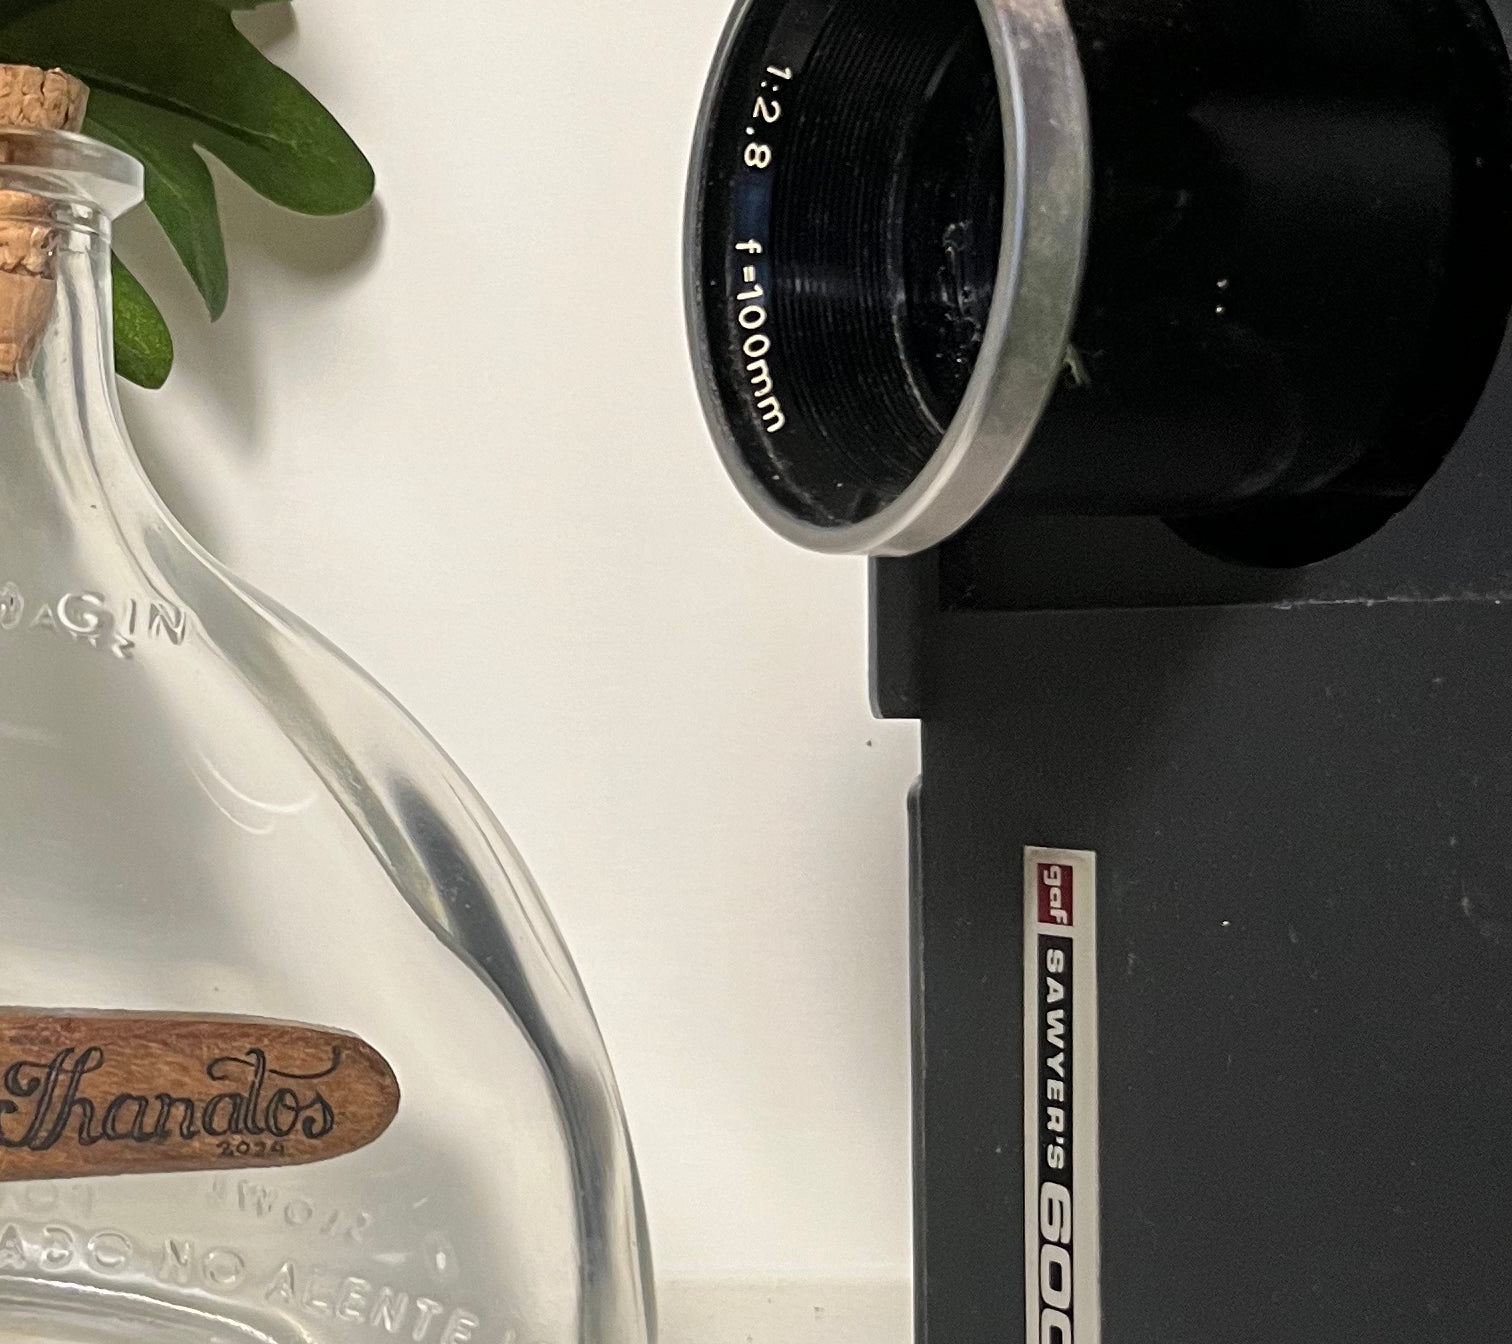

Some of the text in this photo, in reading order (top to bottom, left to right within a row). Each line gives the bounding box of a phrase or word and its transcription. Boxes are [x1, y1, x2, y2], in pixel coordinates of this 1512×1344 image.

[743, 64, 792, 169] 1:2.8
[57, 591, 188, 646] GIN
[1043, 865, 1068, 925] gaf
[1046, 948, 1064, 1170] SAWYER'S
[155, 1238, 246, 1290] NO
